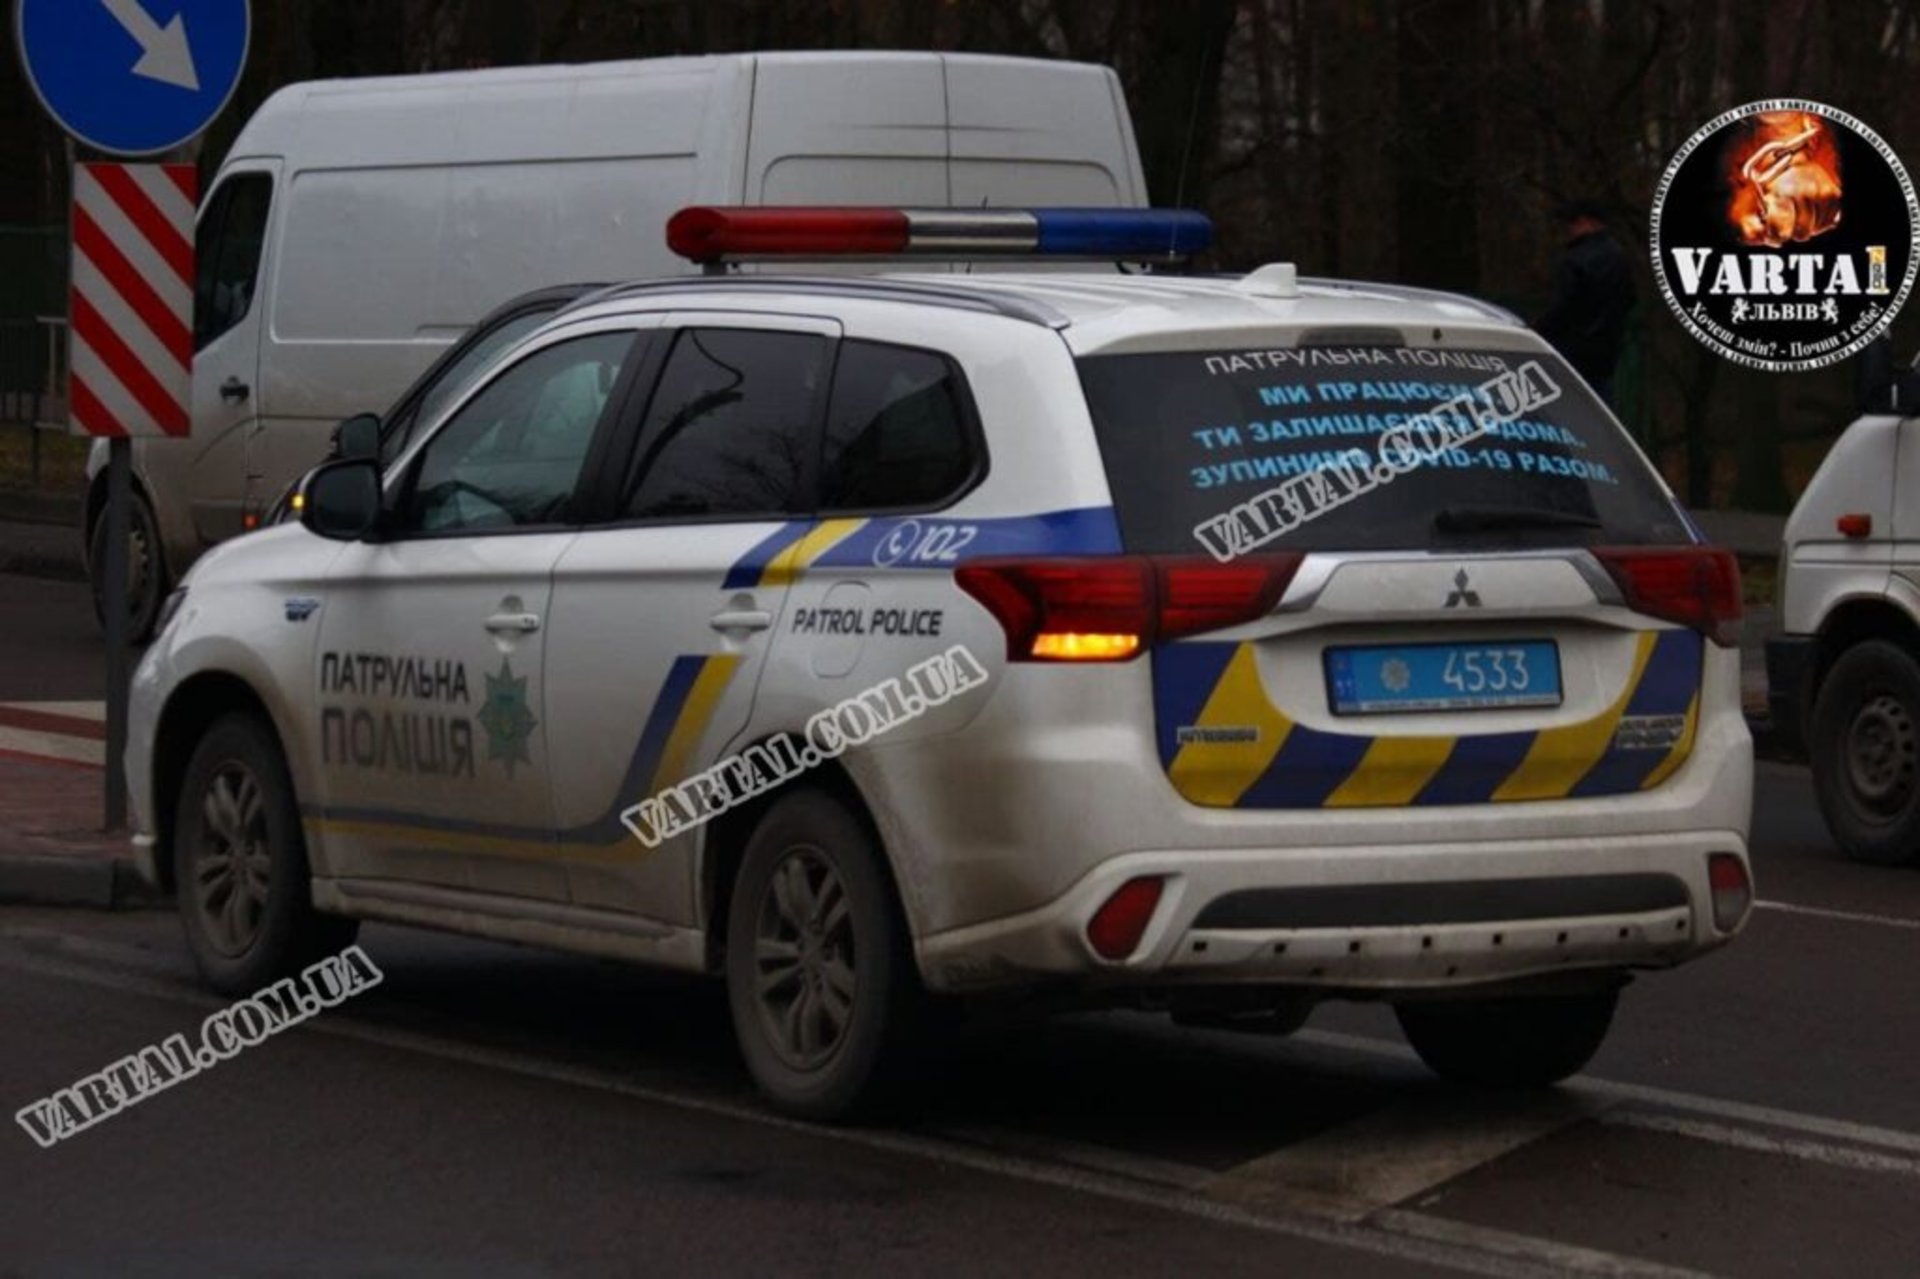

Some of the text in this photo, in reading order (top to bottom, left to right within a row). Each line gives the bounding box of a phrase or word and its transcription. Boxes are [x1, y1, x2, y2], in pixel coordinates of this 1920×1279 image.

[1205, 347, 1510, 375] ПАТРУЛЬНА ПОЛІЦІЯ
[1258, 384, 1312, 406] МИ
[1192, 427, 1242, 448] ТИ
[909, 525, 978, 561] 102
[792, 609, 943, 636] PATROL POLICE
[320, 652, 470, 704] ПАТРУЛЬНА
[1442, 650, 1530, 692] 4533
[321, 707, 475, 779] ПОЛІЦІЯ
